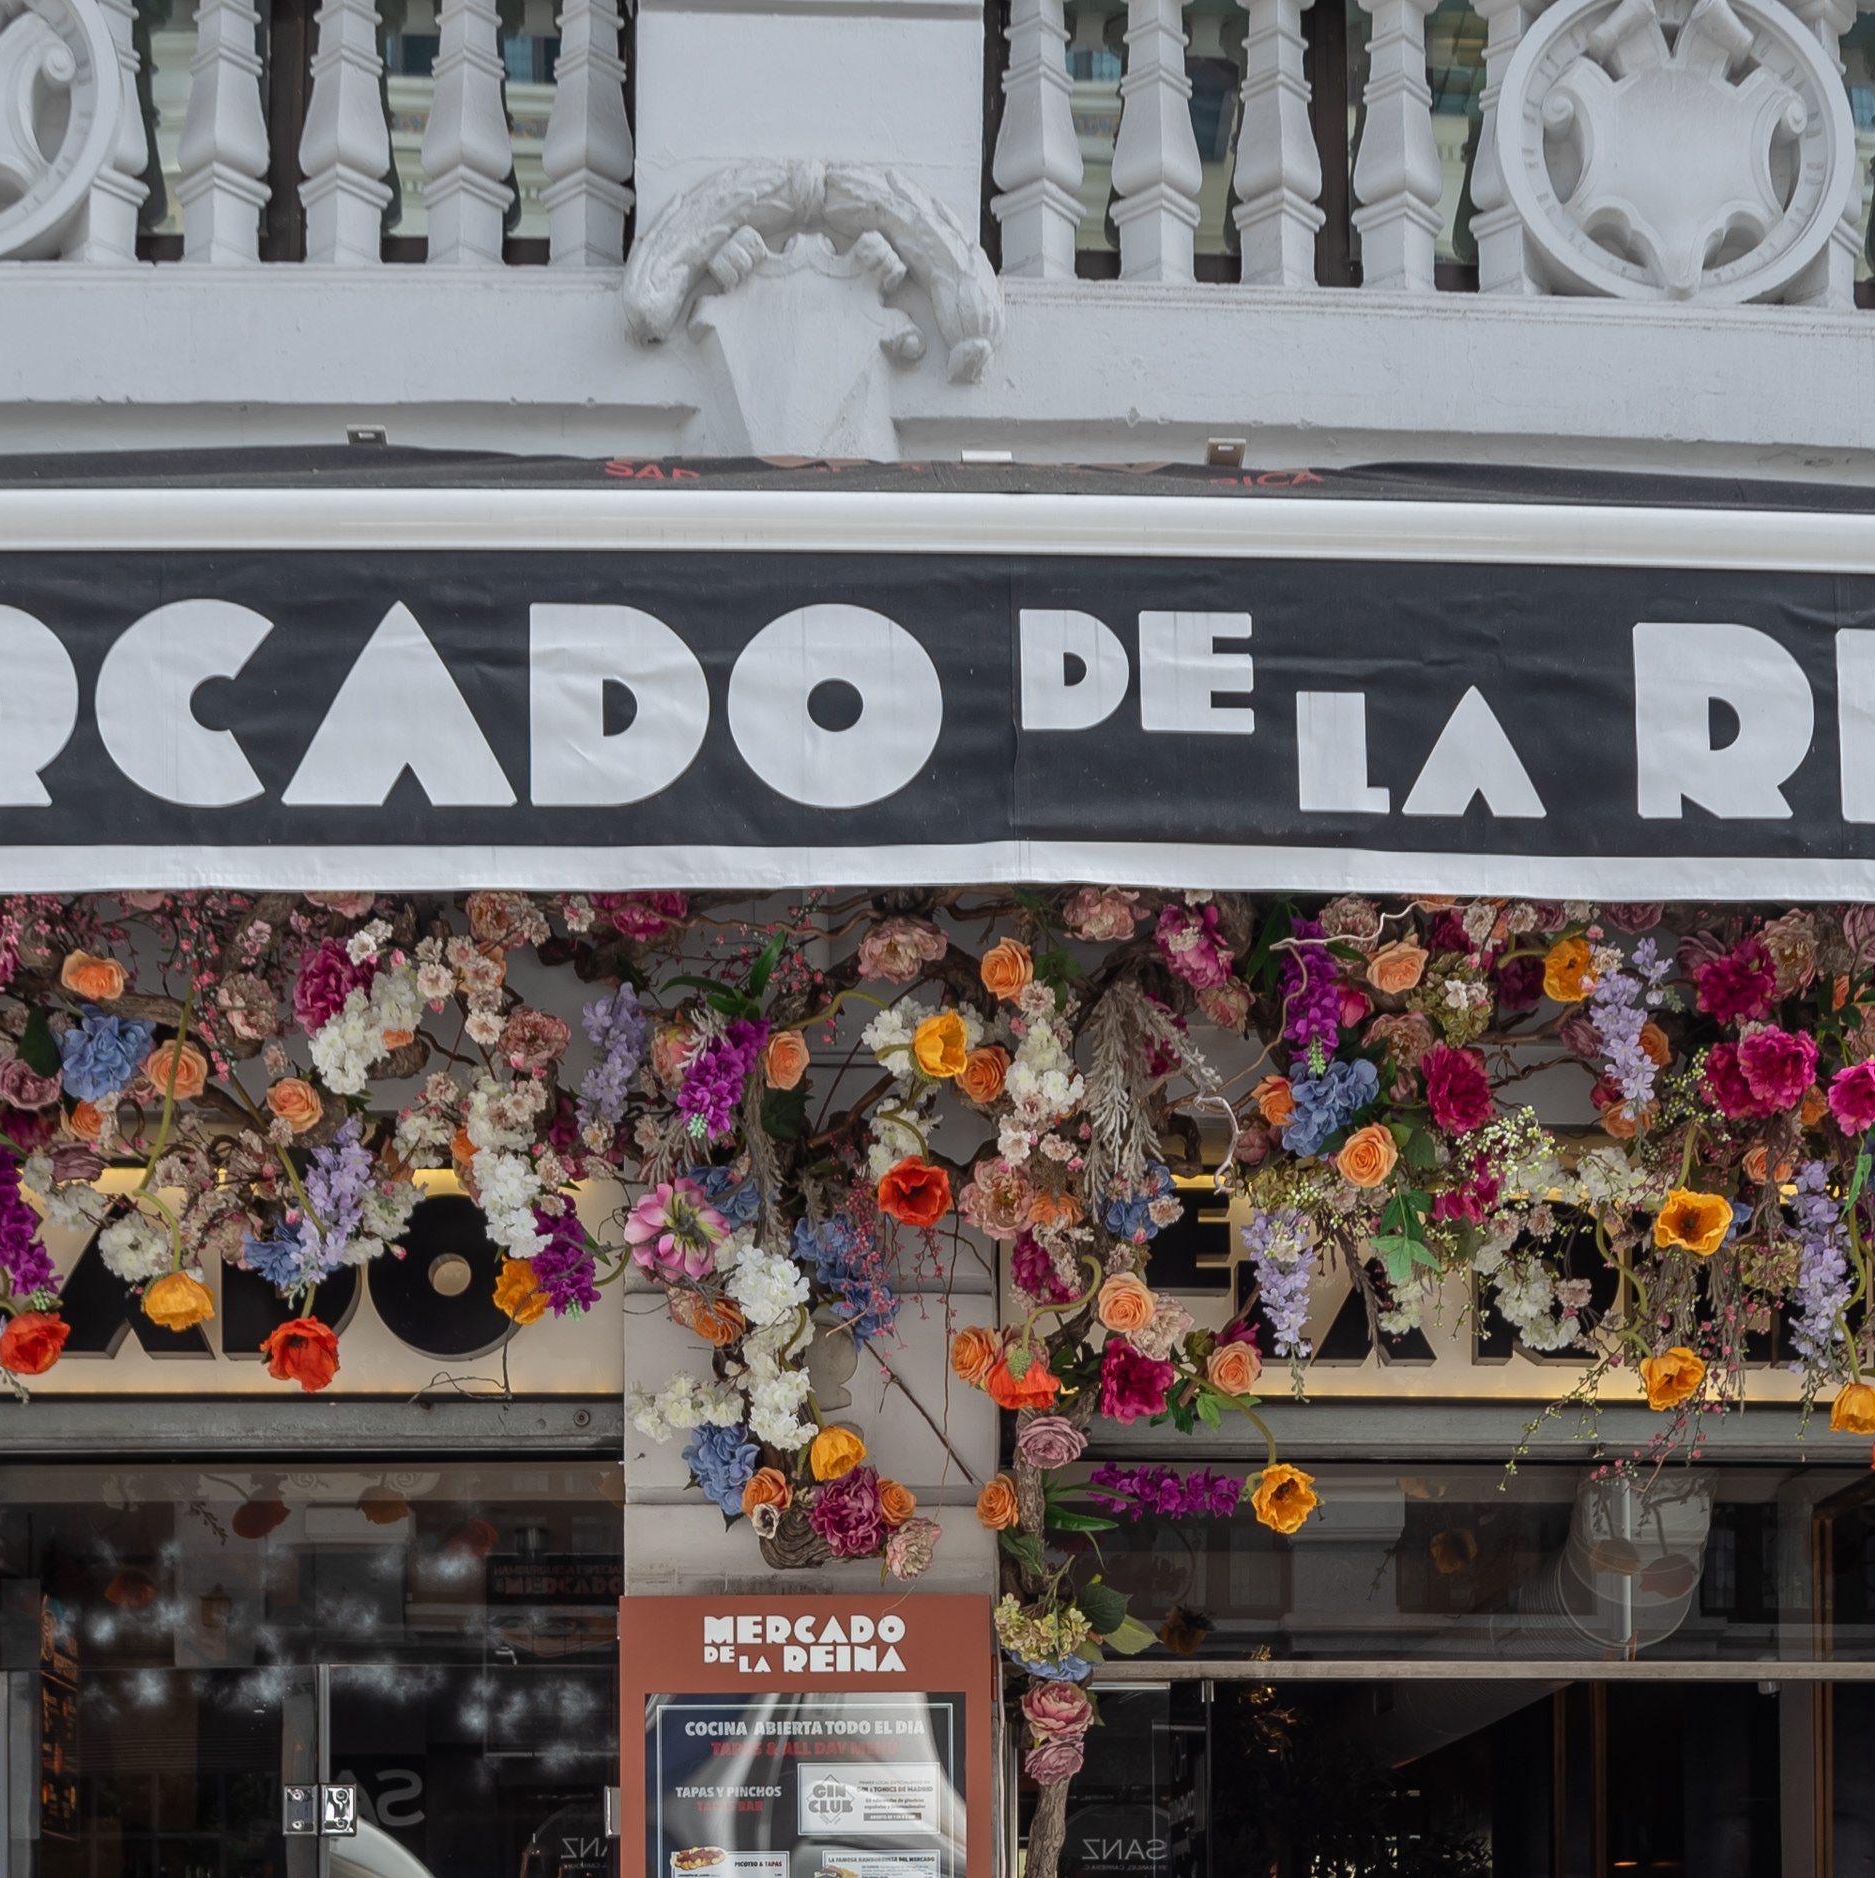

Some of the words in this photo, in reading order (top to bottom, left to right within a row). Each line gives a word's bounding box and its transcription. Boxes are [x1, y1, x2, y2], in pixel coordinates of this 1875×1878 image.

[1018, 608, 1255, 736] DE
[1295, 684, 1547, 819] LA
[703, 1614, 907, 1644] MERCADO
[703, 1645, 735, 1664] DE
[738, 1656, 772, 1673] LA
[782, 1645, 908, 1673] REINA
[685, 1722, 748, 1736] COCINA
[754, 1721, 824, 1736] ABIERTA
[824, 1720, 871, 1735] TODO
[875, 1720, 893, 1734] EL
[896, 1720, 926, 1735] DIA
[783, 1742, 811, 1757] ALL
[815, 1742, 848, 1756] DAY
[675, 1786, 714, 1798] TAPAS
[716, 1786, 725, 1797] Y
[727, 1786, 782, 1798] PINCHOS
[813, 1784, 846, 1799] GIN
[737, 1800, 764, 1812] BAR
[808, 1800, 854, 1813] CLUB
